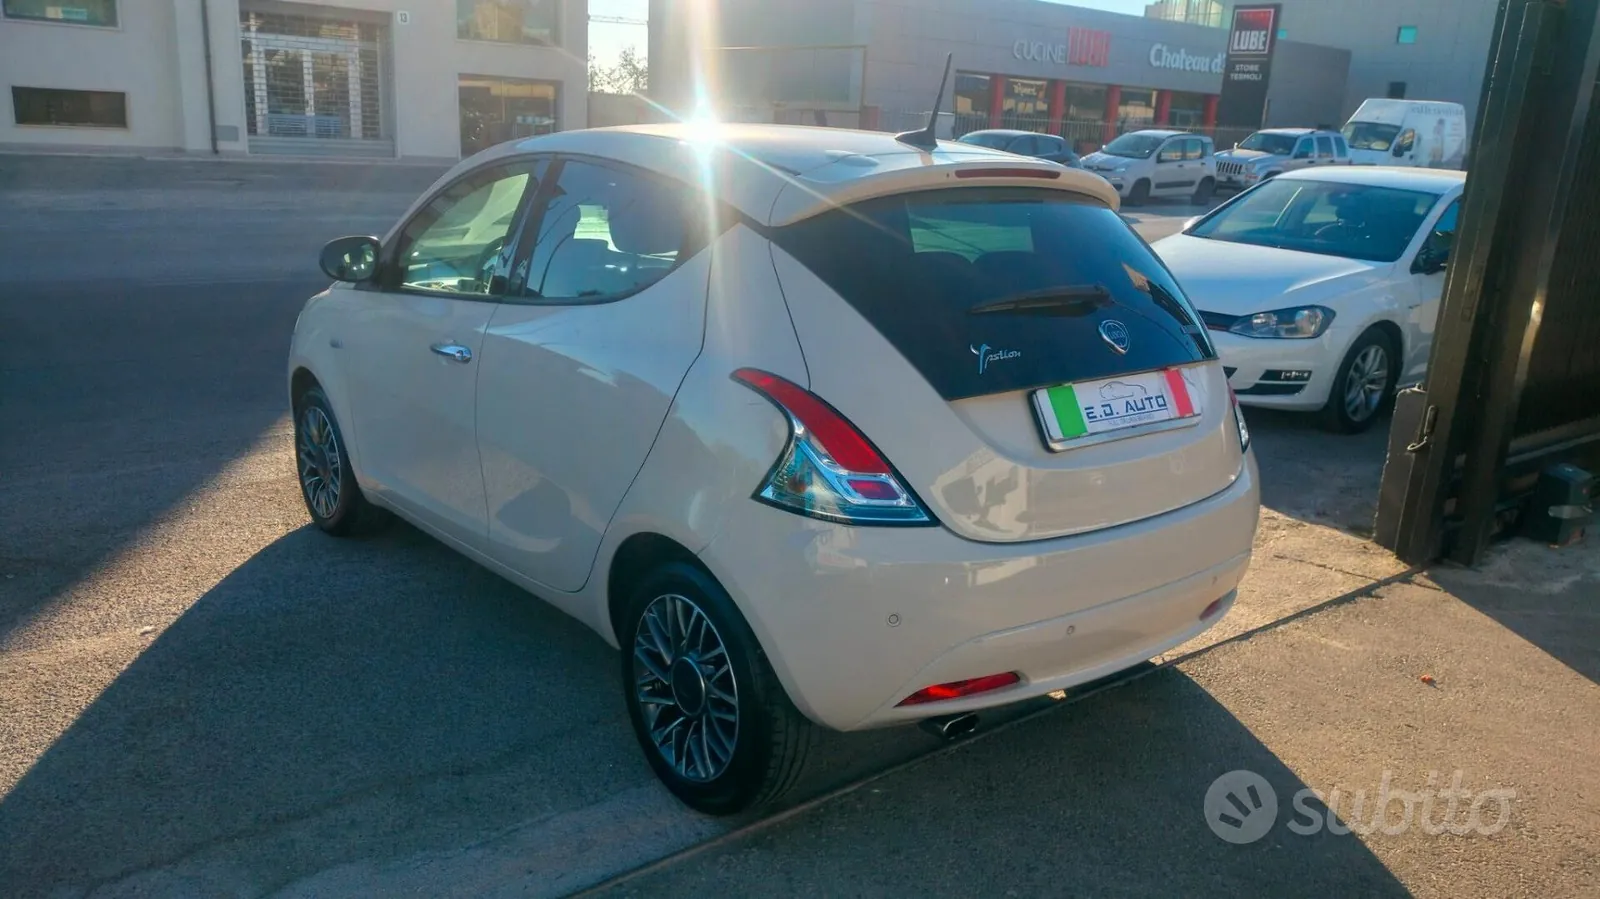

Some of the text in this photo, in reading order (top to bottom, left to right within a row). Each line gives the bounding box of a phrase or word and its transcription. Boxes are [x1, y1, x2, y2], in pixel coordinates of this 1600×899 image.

[399, 12, 408, 23] 13
[1233, 30, 1267, 50] LUBE
[1013, 39, 1066, 64] CUCINE
[1149, 43, 1227, 74] Chateau d'
[1230, 72, 1263, 81] TERMOLI
[1234, 63, 1260, 72] STORE
[970, 343, 1021, 375] Ypsilon
[1084, 403, 1119, 420] E.D.
[1125, 394, 1168, 413] AUTO
